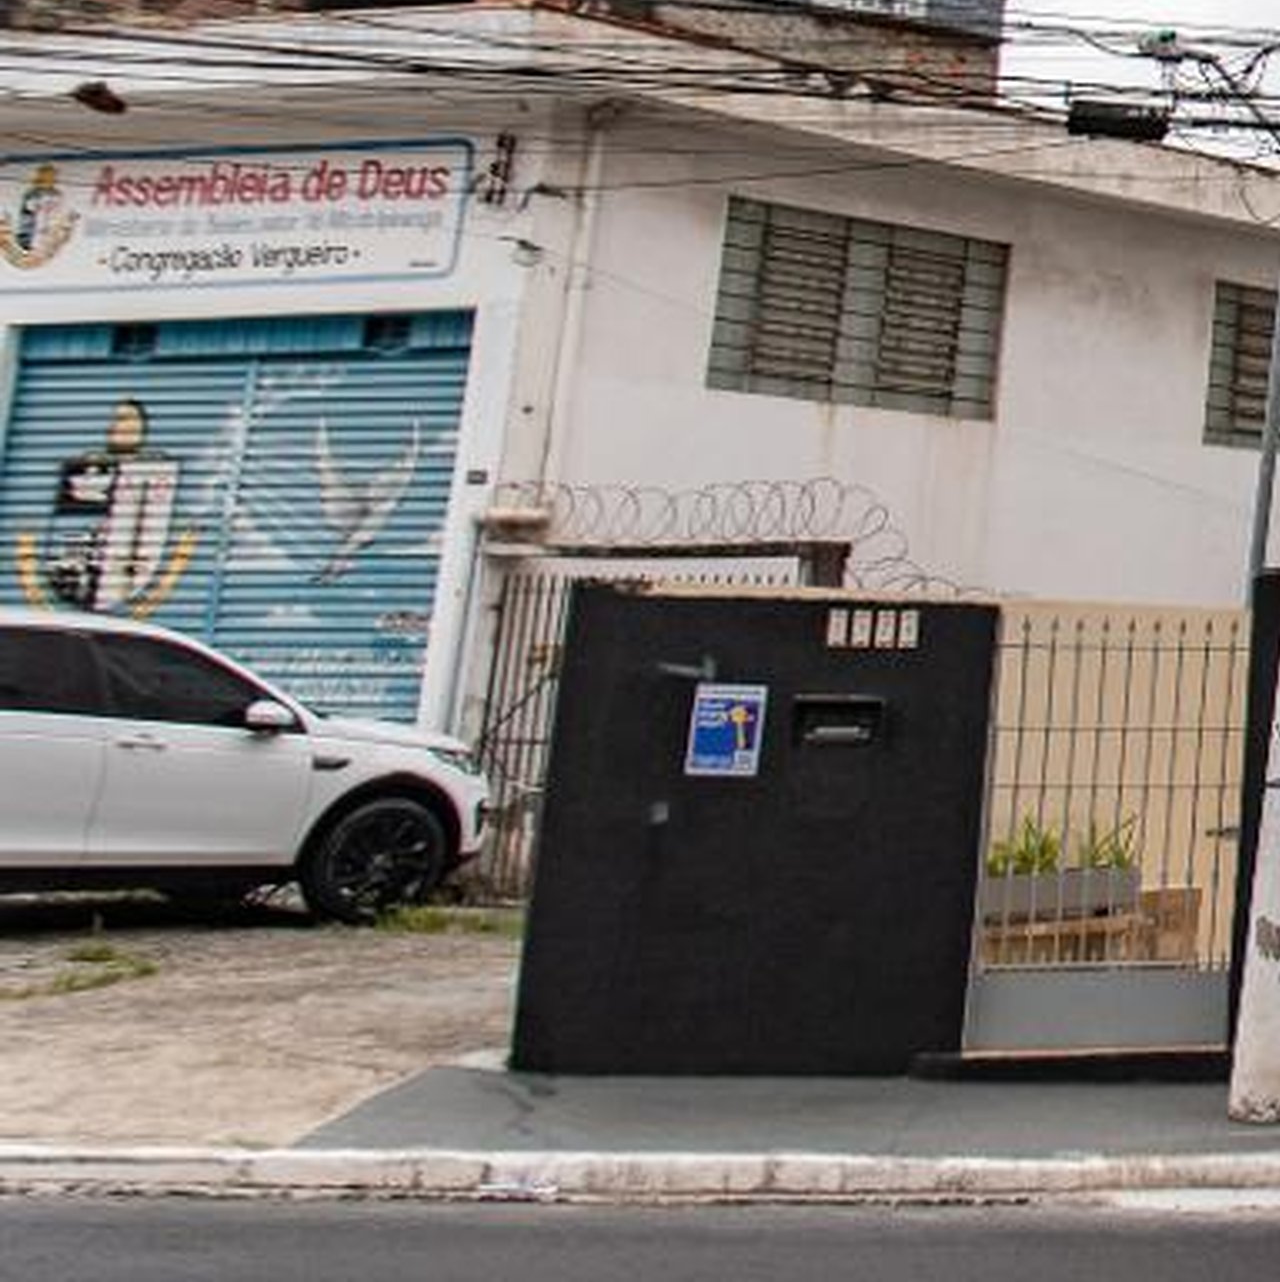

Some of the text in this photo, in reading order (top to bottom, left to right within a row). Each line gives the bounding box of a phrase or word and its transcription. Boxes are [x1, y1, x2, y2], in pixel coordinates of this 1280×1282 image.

[92, 159, 450, 206] Assembleia de Deus
[251, 242, 349, 275] Vergueiro
